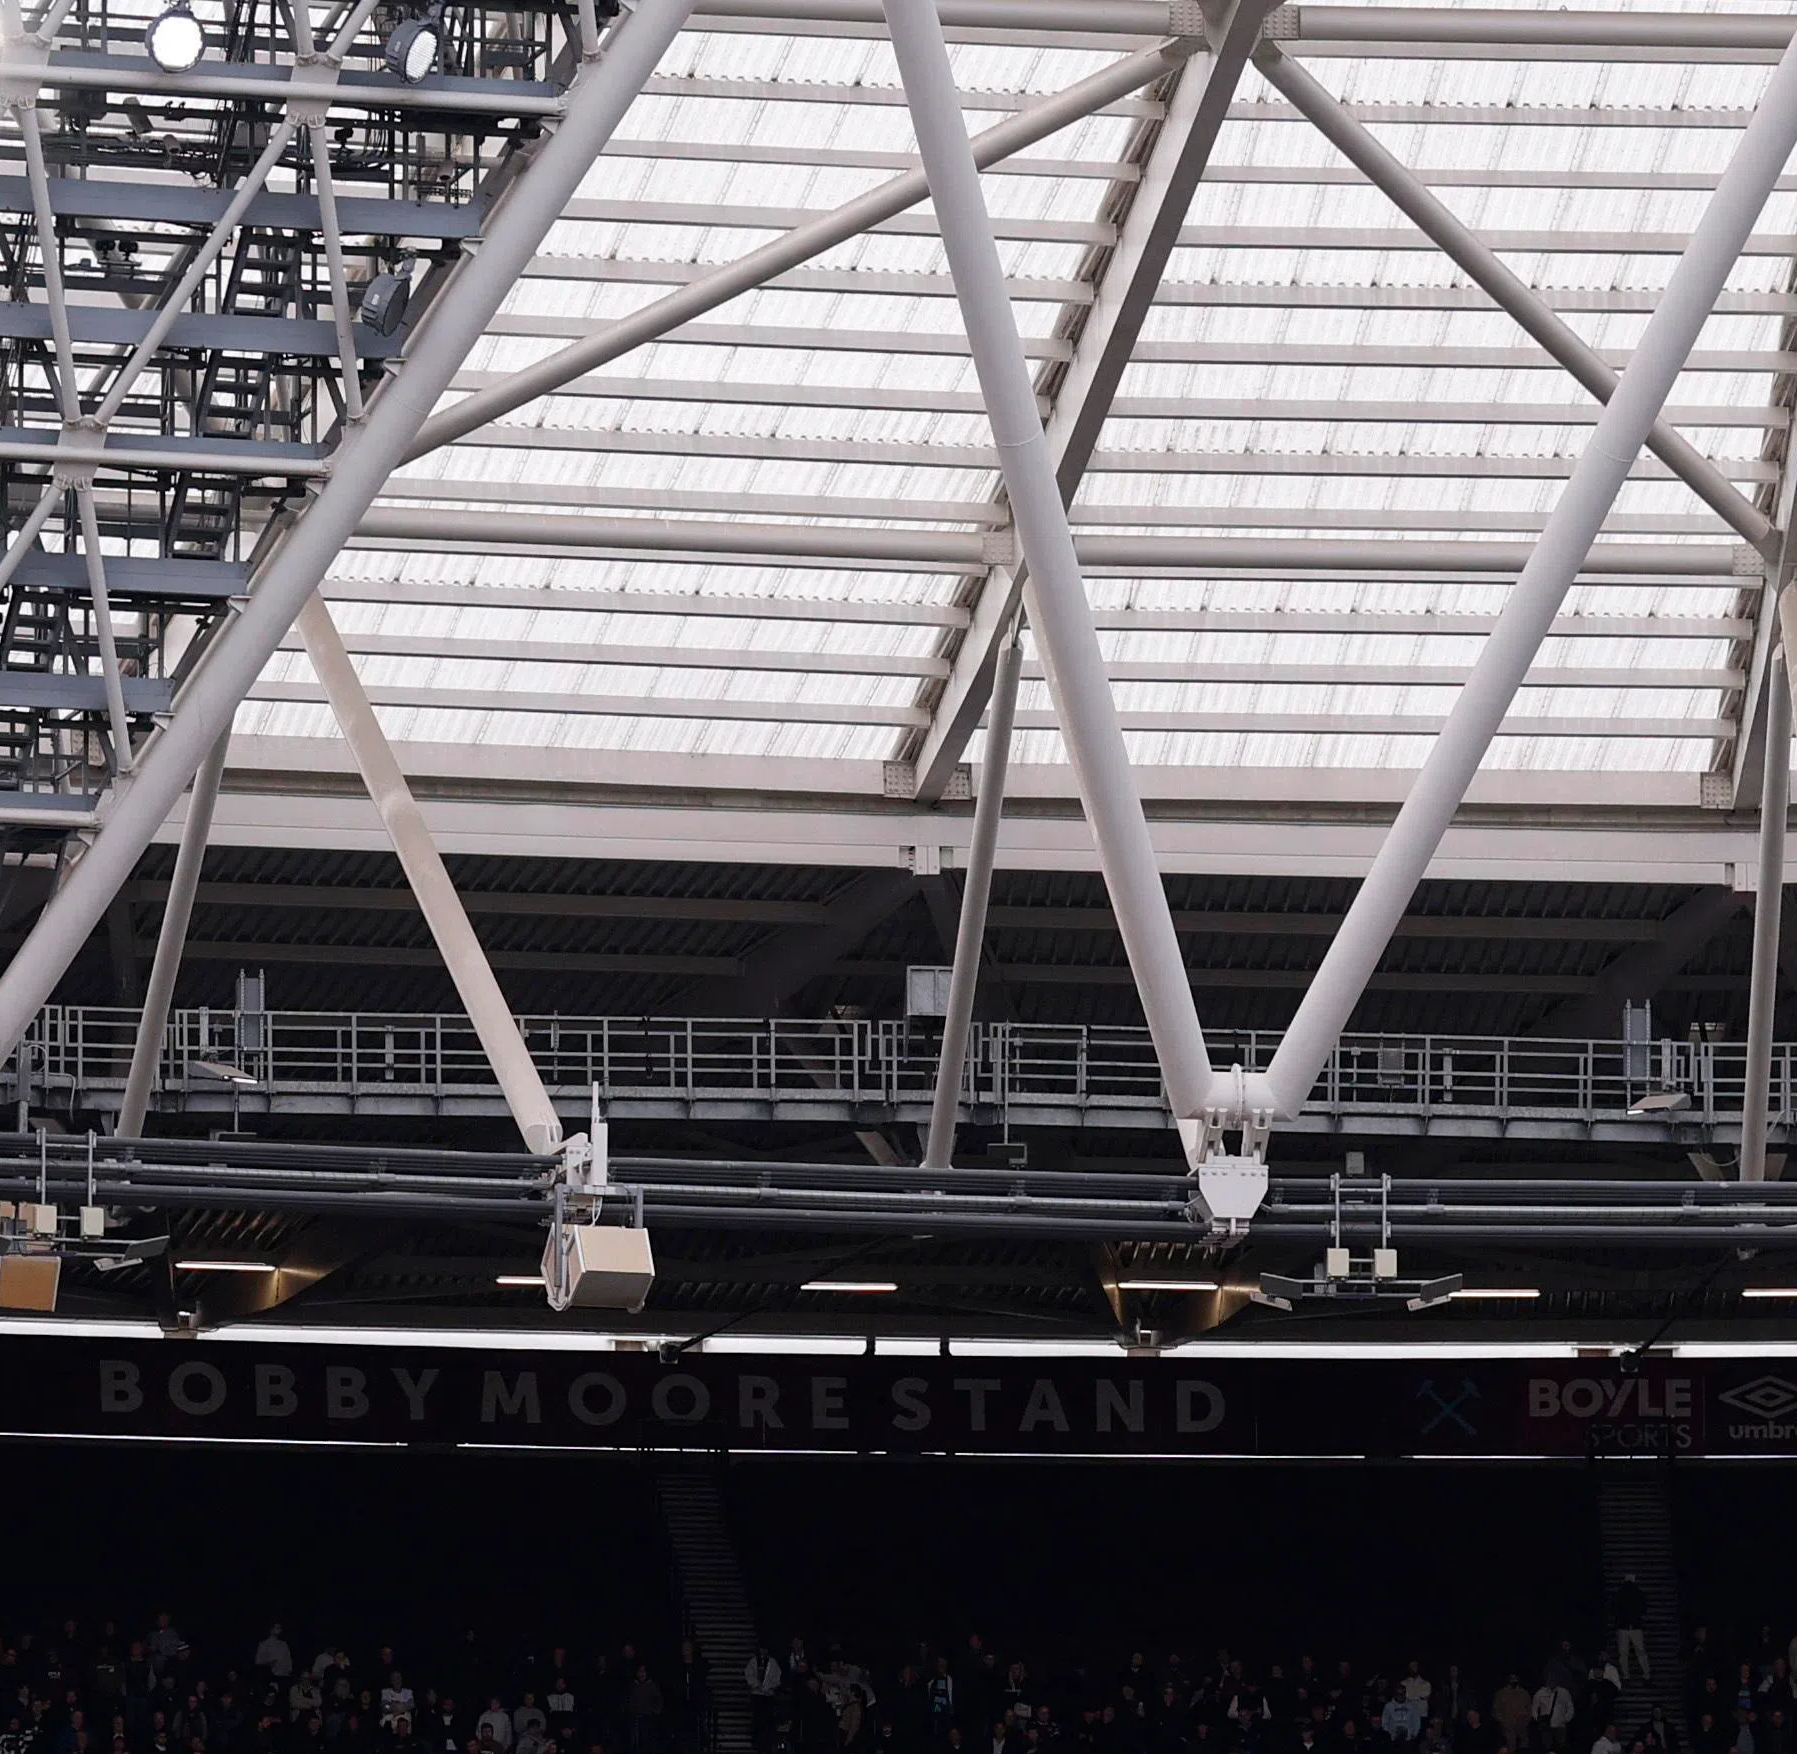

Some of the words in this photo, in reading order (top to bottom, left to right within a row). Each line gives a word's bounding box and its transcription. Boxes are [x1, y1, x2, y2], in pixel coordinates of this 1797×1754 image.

[100, 1359, 440, 1422] BOBBY
[482, 1369, 851, 1430] MOORE
[892, 1377, 1227, 1435] STAND
[1529, 1379, 1692, 1418] BOYLE
